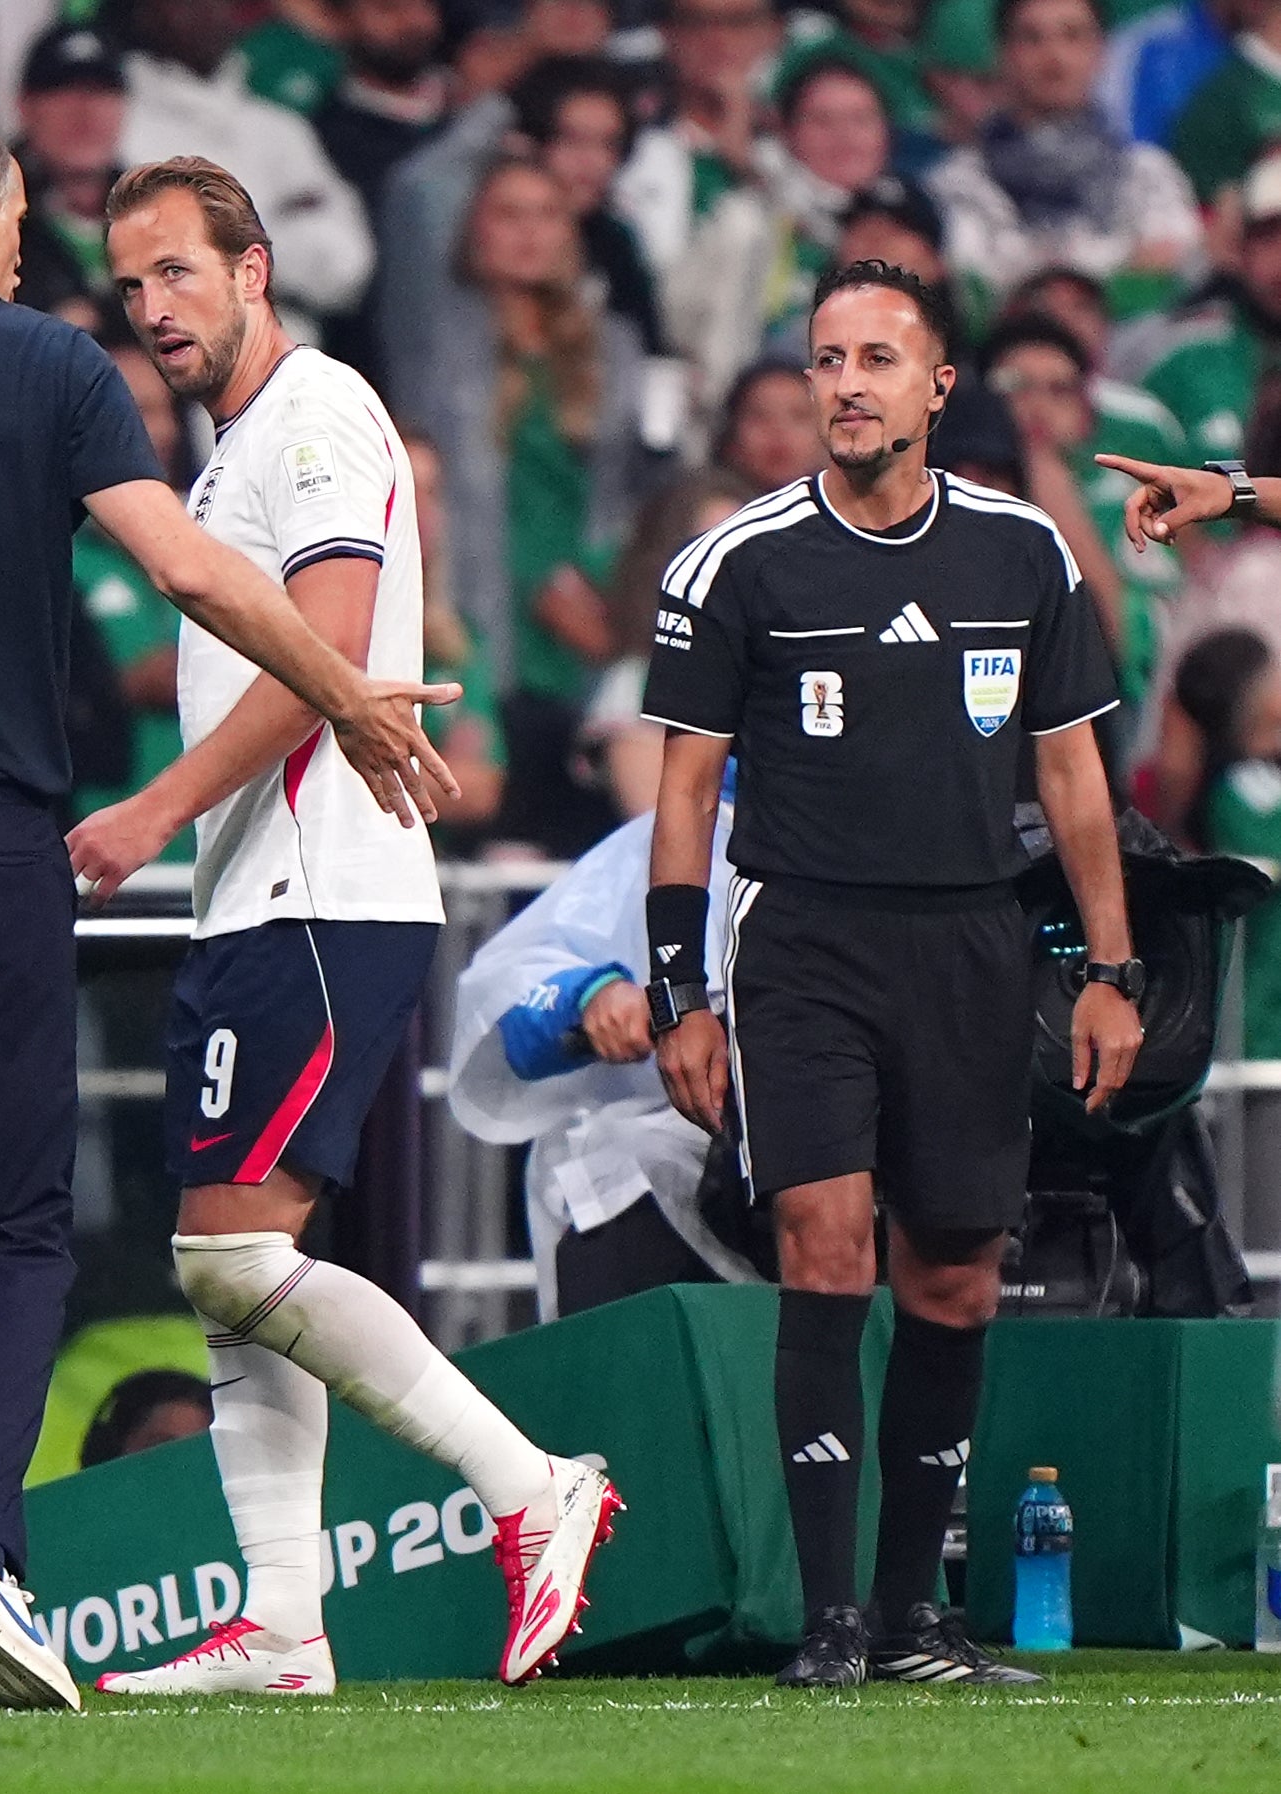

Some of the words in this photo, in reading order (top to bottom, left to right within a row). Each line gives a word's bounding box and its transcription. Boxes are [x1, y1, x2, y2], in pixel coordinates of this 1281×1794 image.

[296, 474, 332, 491] EDUCATION
[654, 633, 669, 645] AM
[668, 637, 692, 651] ONE
[970, 656, 1015, 677] FIFA
[814, 722, 832, 730] FIFA
[200, 1028, 238, 1119] 9
